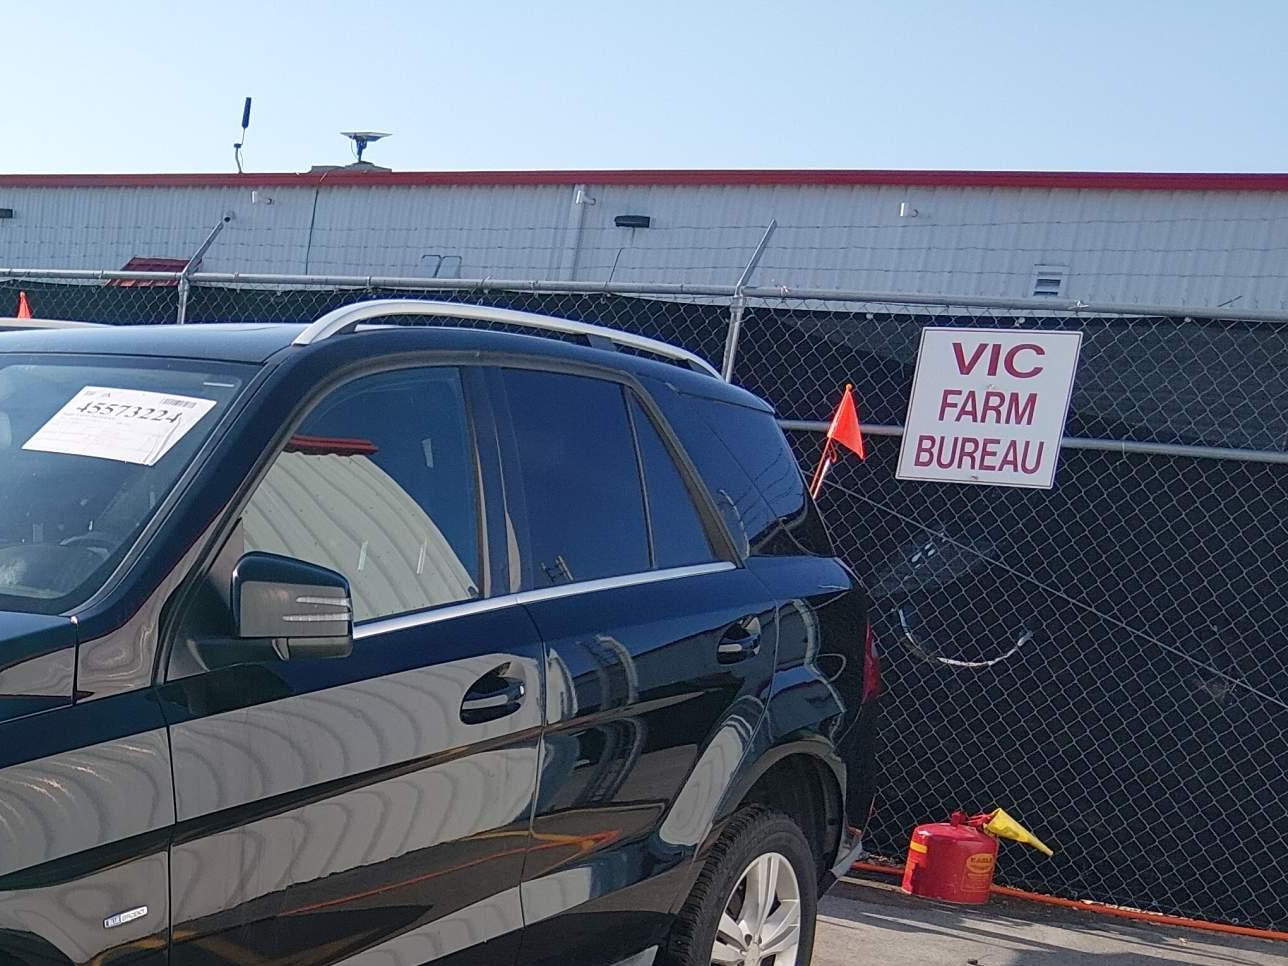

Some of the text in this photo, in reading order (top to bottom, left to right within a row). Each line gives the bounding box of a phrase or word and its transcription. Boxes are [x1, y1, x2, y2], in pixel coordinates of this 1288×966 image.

[951, 342, 1046, 379] VIC
[76, 401, 183, 424] 45573224
[938, 389, 1038, 426] FARM
[913, 434, 1045, 475] BUREAU
